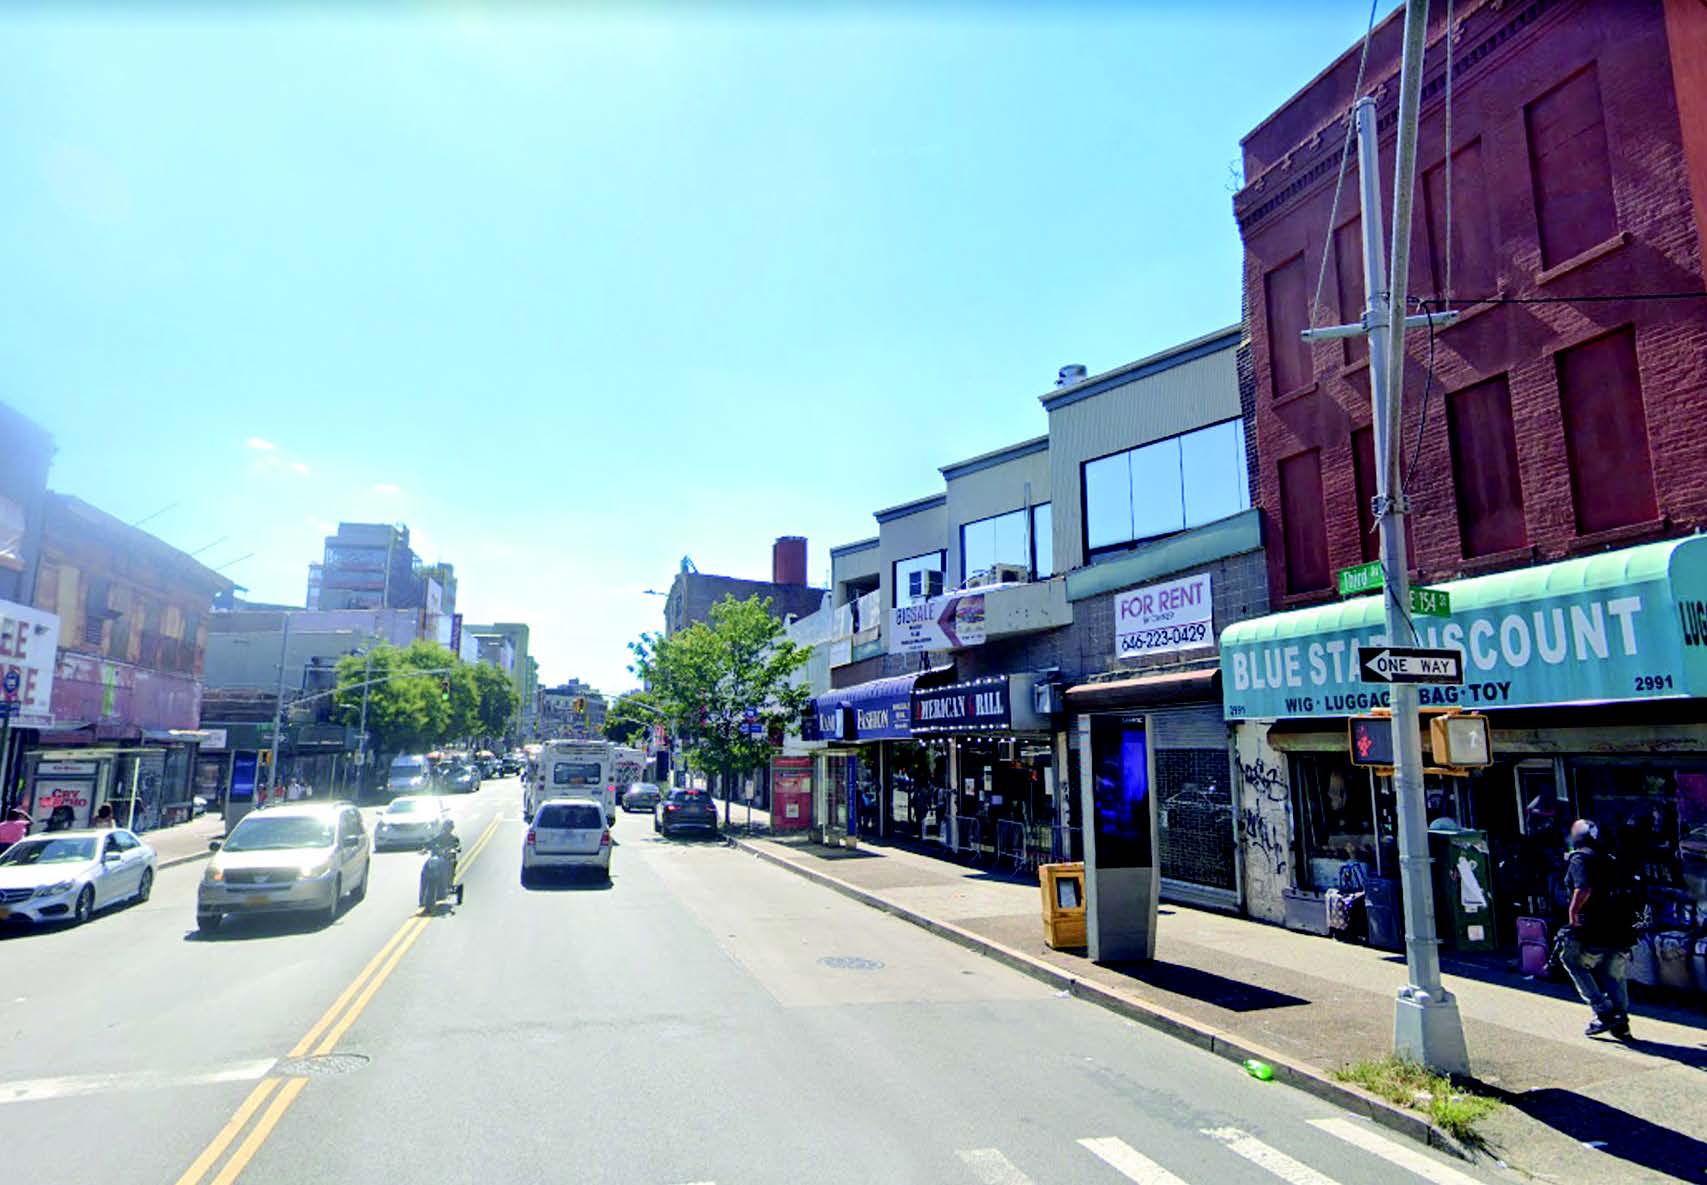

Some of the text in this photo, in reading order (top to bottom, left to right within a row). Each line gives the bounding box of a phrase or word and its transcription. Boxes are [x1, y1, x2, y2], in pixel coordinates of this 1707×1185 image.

[1343, 568, 1368, 590] Third
[1120, 594, 1154, 620] FOR
[1158, 581, 1204, 613] RENT
[1420, 591, 1437, 612] 154
[1121, 623, 1206, 651] 646-223-0429
[1232, 644, 1303, 691] BLUE
[1377, 658, 1449, 673] ONE WAY
[1635, 674, 1674, 691] 2991
[1285, 681, 1512, 713] WIG LUGGAG BAG TOY
